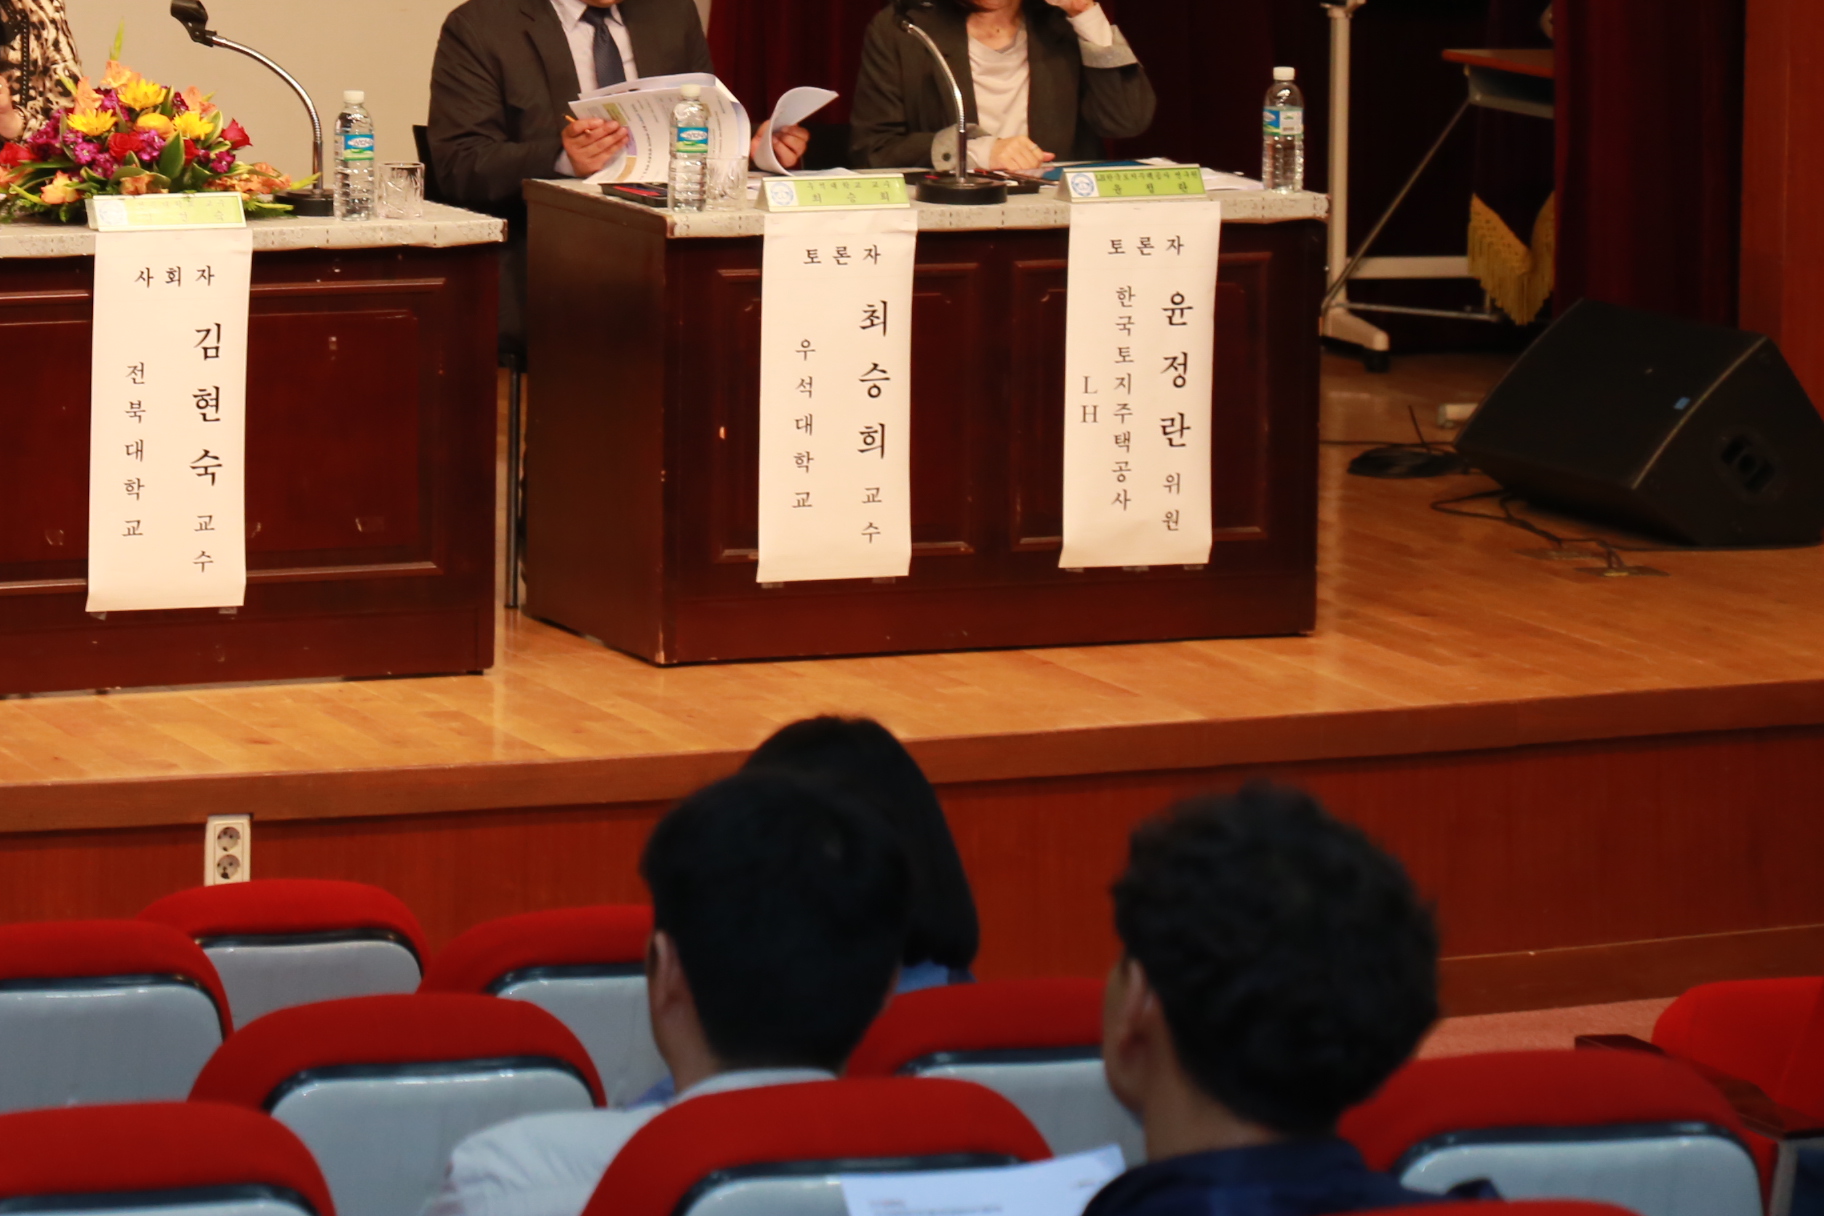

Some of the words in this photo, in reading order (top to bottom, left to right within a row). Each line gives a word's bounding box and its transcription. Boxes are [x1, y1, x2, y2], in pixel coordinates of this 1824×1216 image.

[122, 361, 146, 537] 전북대학교
[190, 322, 223, 486] 김현숙
[792, 338, 816, 509] 우석대학교
[857, 300, 891, 459] 최승희
[1112, 285, 1136, 511] 한국토지주택공사
[1160, 291, 1194, 448] 윤정란
[193, 514, 215, 573] 교수
[861, 486, 882, 544] 교수
[1162, 472, 1181, 532] 위원
